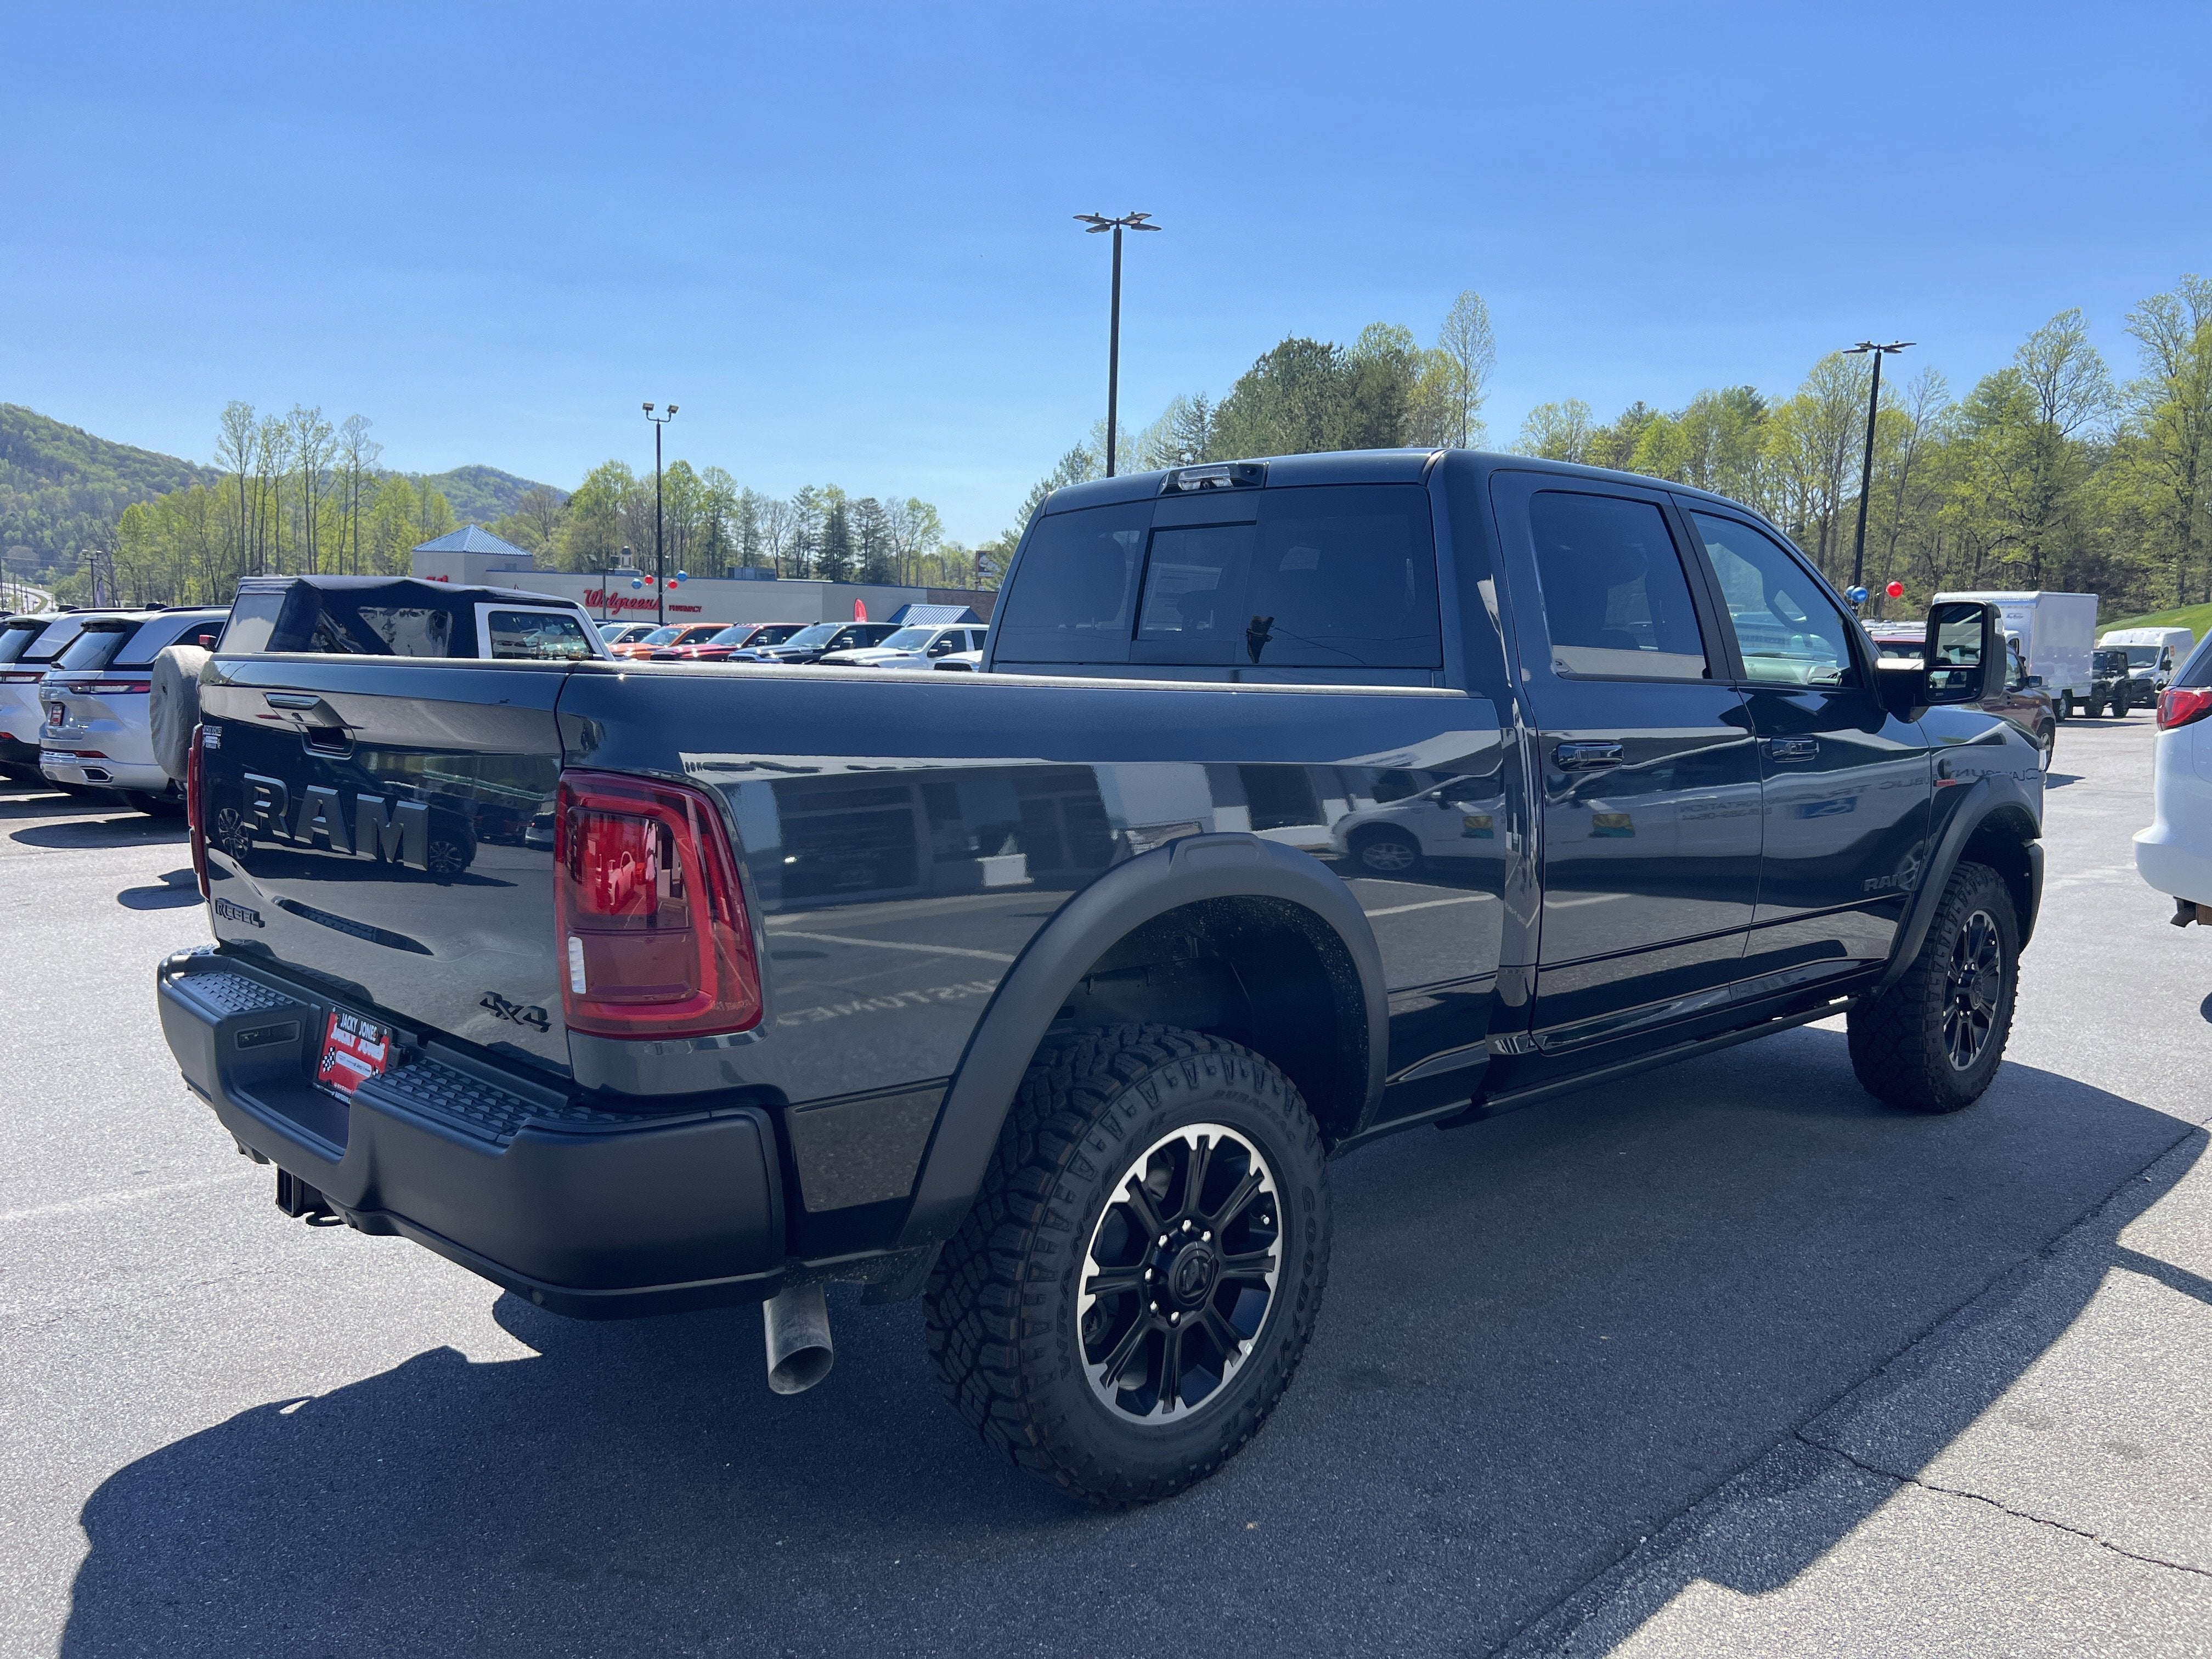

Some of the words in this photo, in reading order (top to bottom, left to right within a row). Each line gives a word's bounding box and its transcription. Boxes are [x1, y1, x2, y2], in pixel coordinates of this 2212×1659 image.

[583, 589, 659, 615] Walgreens
[668, 605, 702, 613] PHARMACY
[243, 772, 429, 871] RAM
[215, 898, 265, 928] REBEL
[340, 1013, 358, 1032] JACKY
[359, 1021, 377, 1041] JONES
